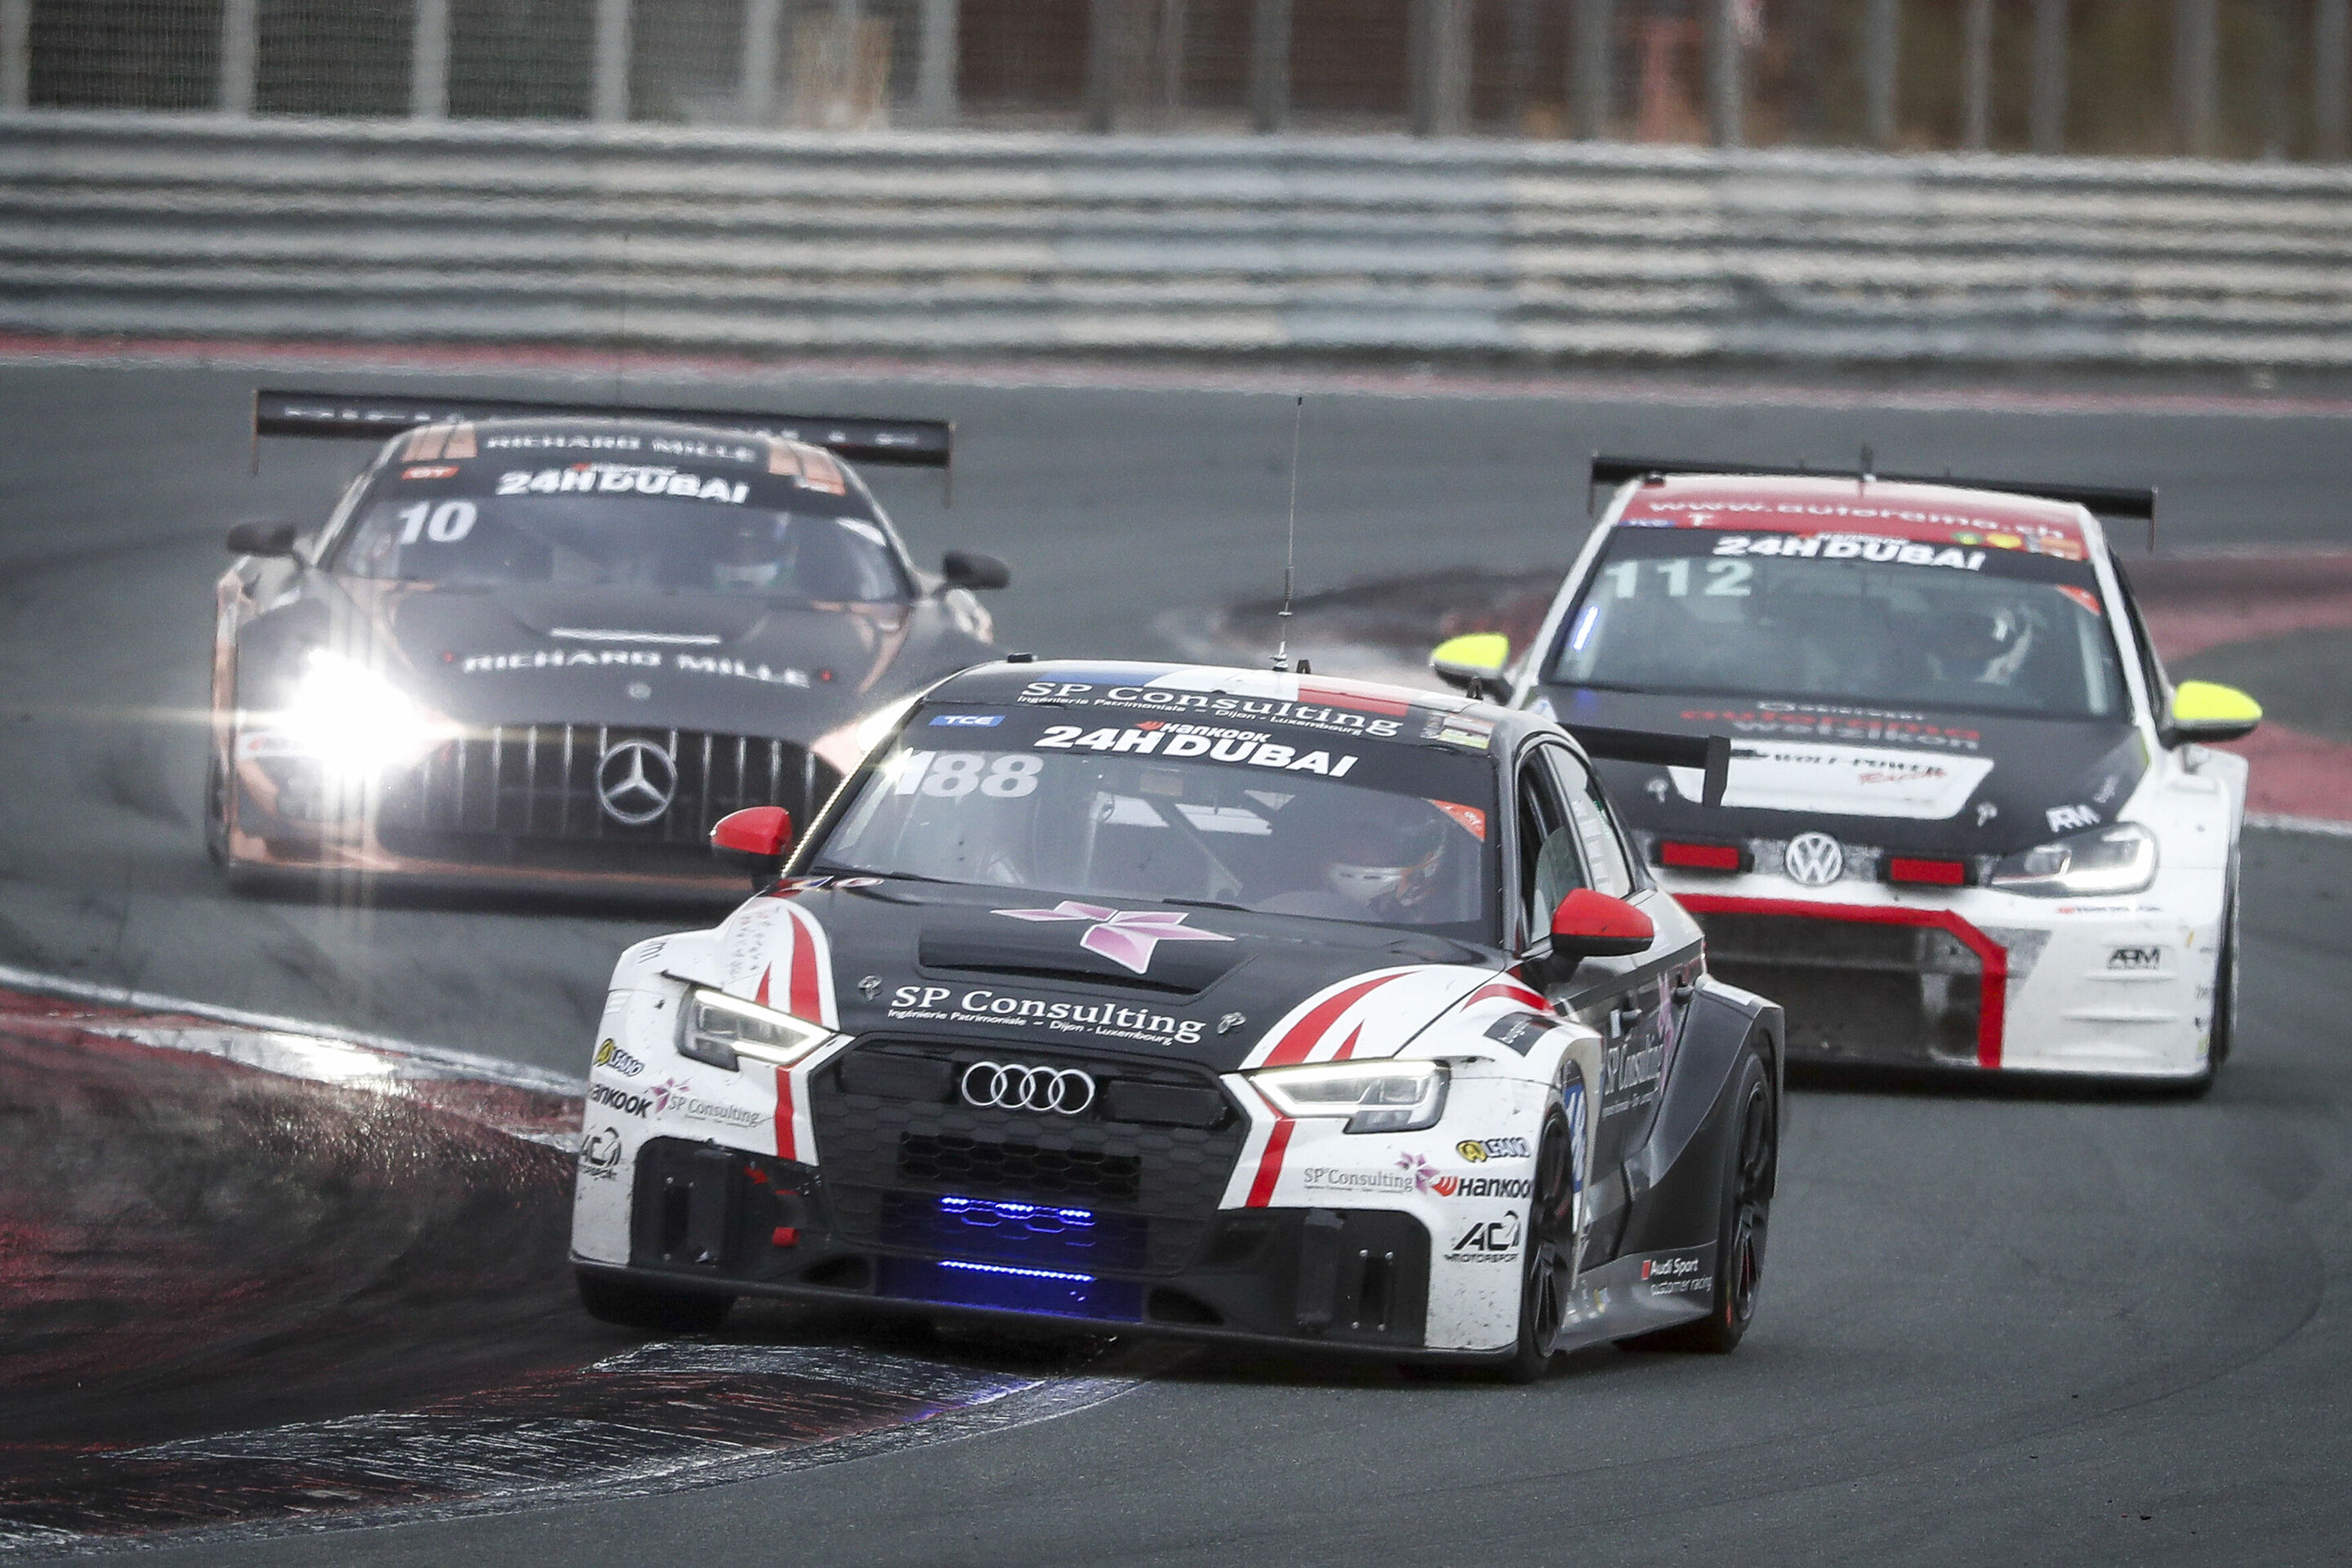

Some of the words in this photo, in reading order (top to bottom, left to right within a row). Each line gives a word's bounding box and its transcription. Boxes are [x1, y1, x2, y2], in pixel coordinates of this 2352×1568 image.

[599, 468, 750, 504] DUBAI
[397, 500, 479, 544] 10
[1823, 537, 1986, 571] DUBAI
[1604, 559, 1754, 598] 112
[944, 715, 996, 725] TCE
[1022, 681, 1093, 697] SP
[1107, 686, 1404, 737] Consulting
[1270, 715, 1363, 737] Luxembourg
[1034, 725, 1166, 754] 24H
[1162, 732, 1359, 777] DUBAI
[891, 986, 951, 1008] SP
[961, 990, 1207, 1044] Consulting
[687, 1098, 762, 1128] Consulting
[1303, 1167, 1324, 1183] SP
[1327, 1168, 1414, 1193] Consulting
[1650, 1258, 1673, 1276] Audi
[1673, 1258, 1699, 1278] Sport
